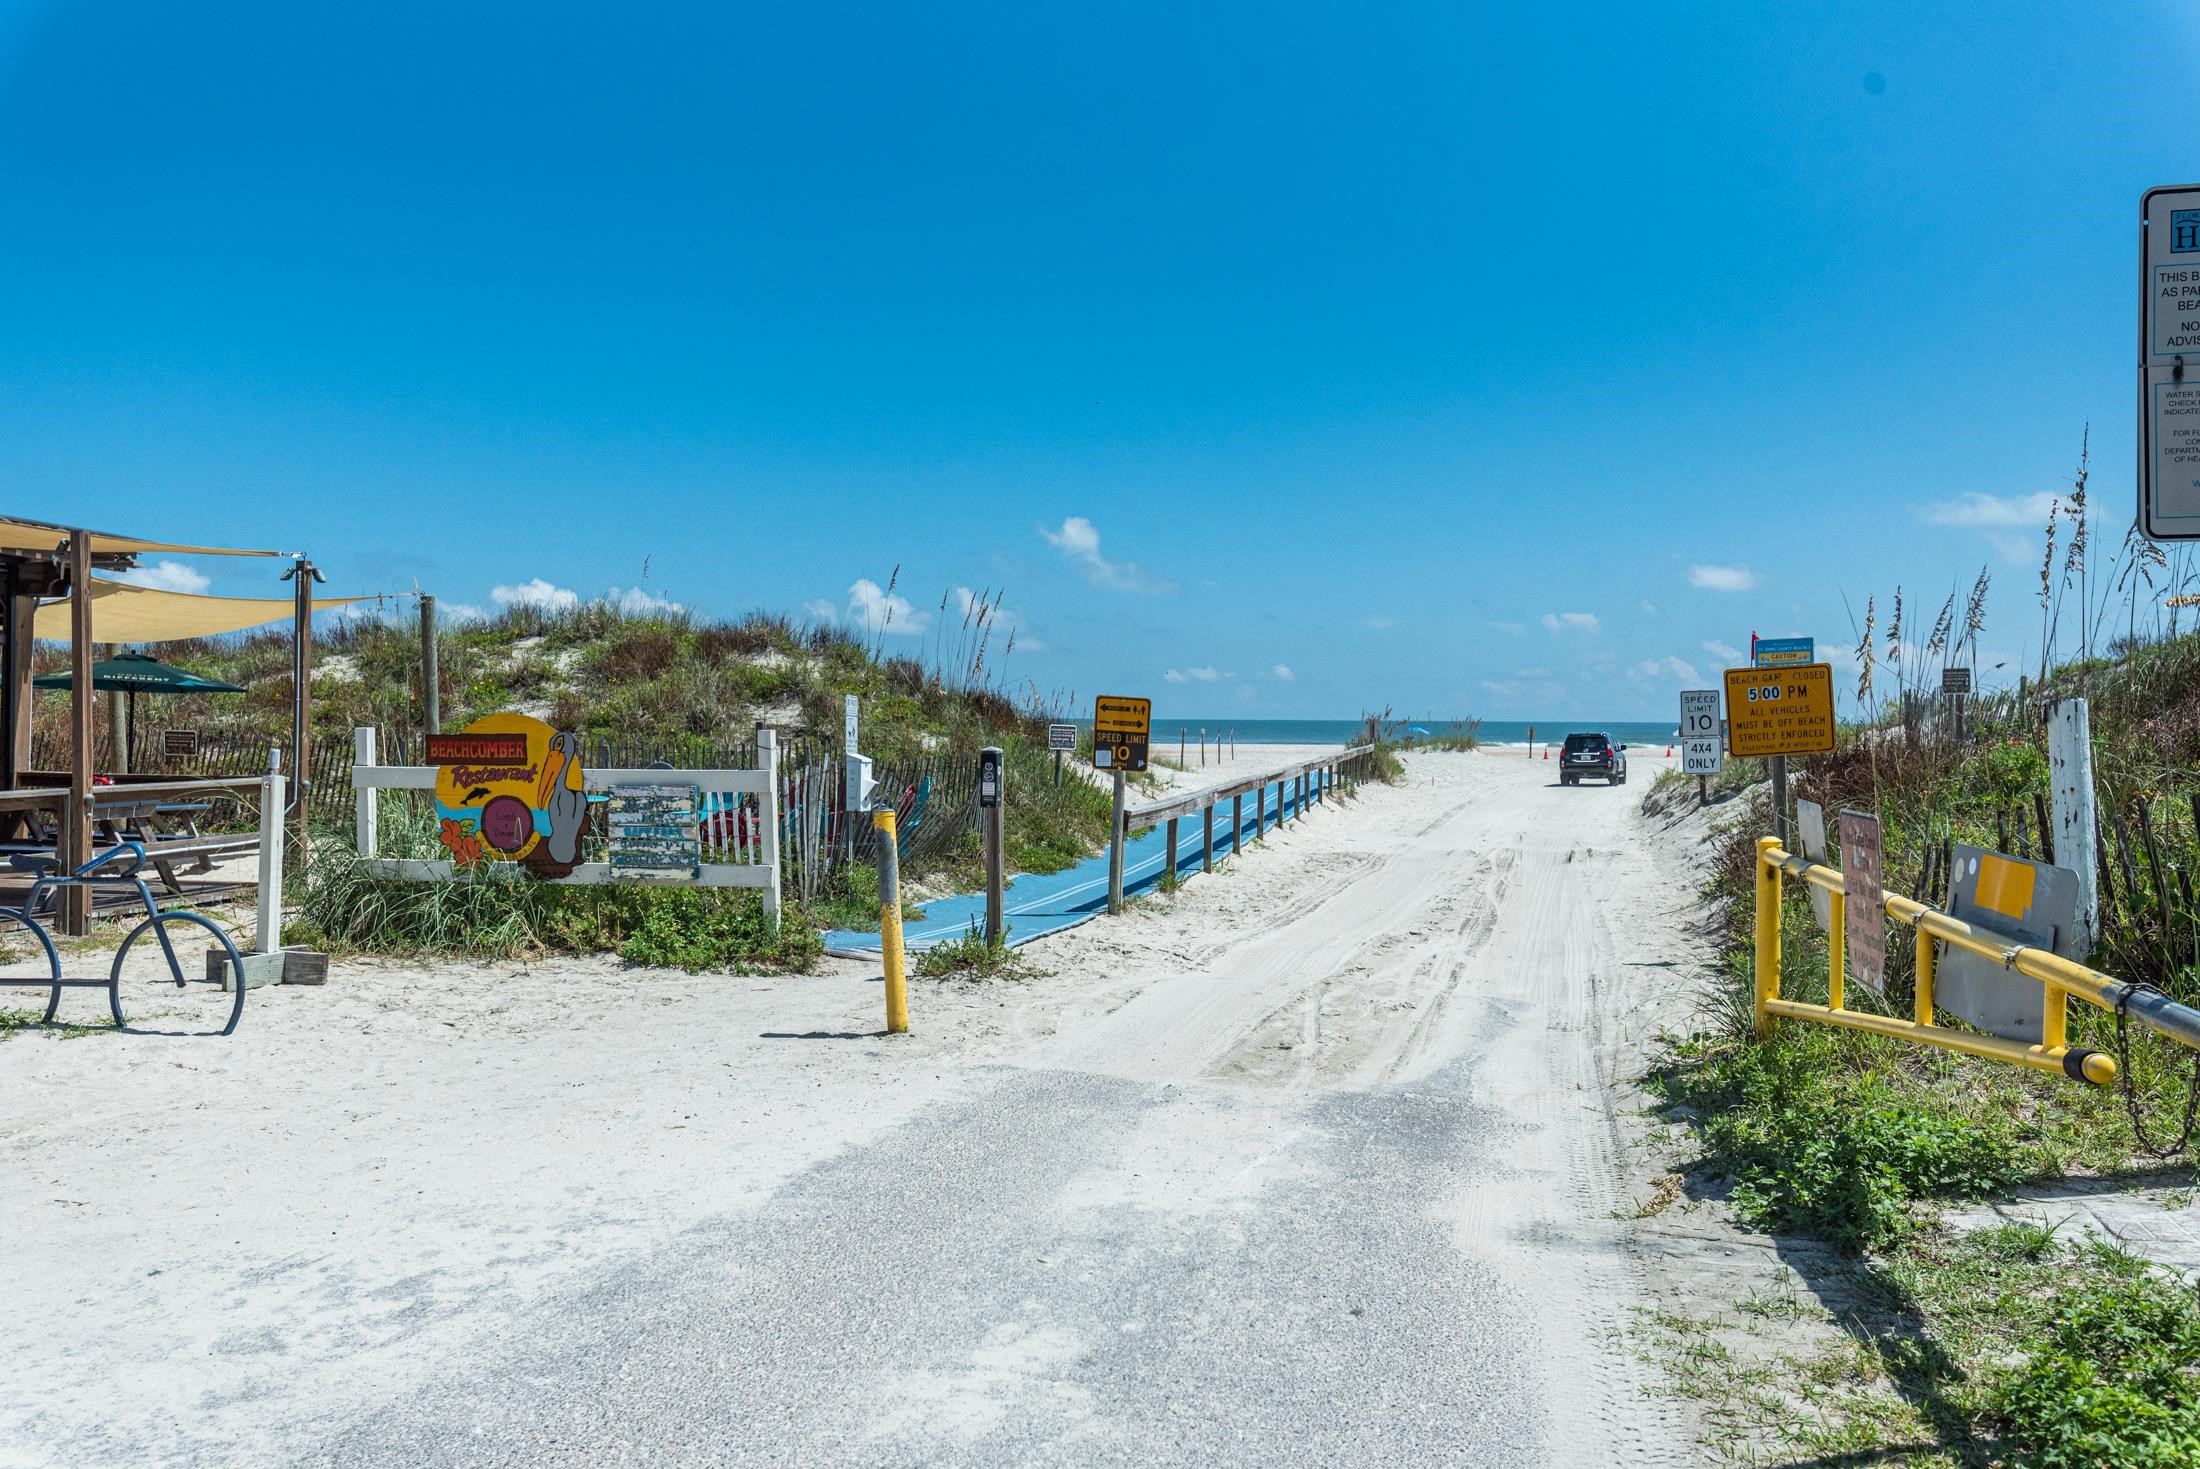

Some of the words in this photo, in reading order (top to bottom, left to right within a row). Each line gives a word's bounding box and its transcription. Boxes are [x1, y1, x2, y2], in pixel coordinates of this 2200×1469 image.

[2160, 271, 2188, 282] THIS
[2161, 286, 2178, 298] AS
[2182, 320, 2200, 332] NO
[2166, 391, 2194, 399] WATER
[2169, 399, 2197, 407] CHECK
[2173, 429, 2190, 437] FOR
[2175, 455, 2186, 463] OF
[1771, 652, 1797, 660] CAUTION
[1793, 671, 1825, 681] CLOSED
[1788, 684, 1808, 699] PM
[1684, 695, 1717, 704] SPEED
[1688, 704, 1713, 713] LIMIT
[1750, 708, 1764, 717] ALL
[1769, 705, 1810, 715] VEHICLES
[1689, 714, 1713, 731] 10
[1737, 720, 1758, 730] MUST
[1763, 719, 1774, 729] BE
[1778, 718, 1793, 728] OFF
[1798, 716, 1826, 726] BEACH
[1097, 733, 1121, 742] SPEED
[1126, 735, 1146, 744] LIMIT
[1738, 732, 1776, 743] STRICTLY
[1781, 728, 1825, 740] ENFORCED
[430, 740, 525, 759] BEACHCOMBER
[1111, 745, 1130, 761] 10
[1691, 743, 1712, 754] 4X4
[1687, 757, 1717, 769] ONLY
[452, 763, 537, 789] Restaurant
